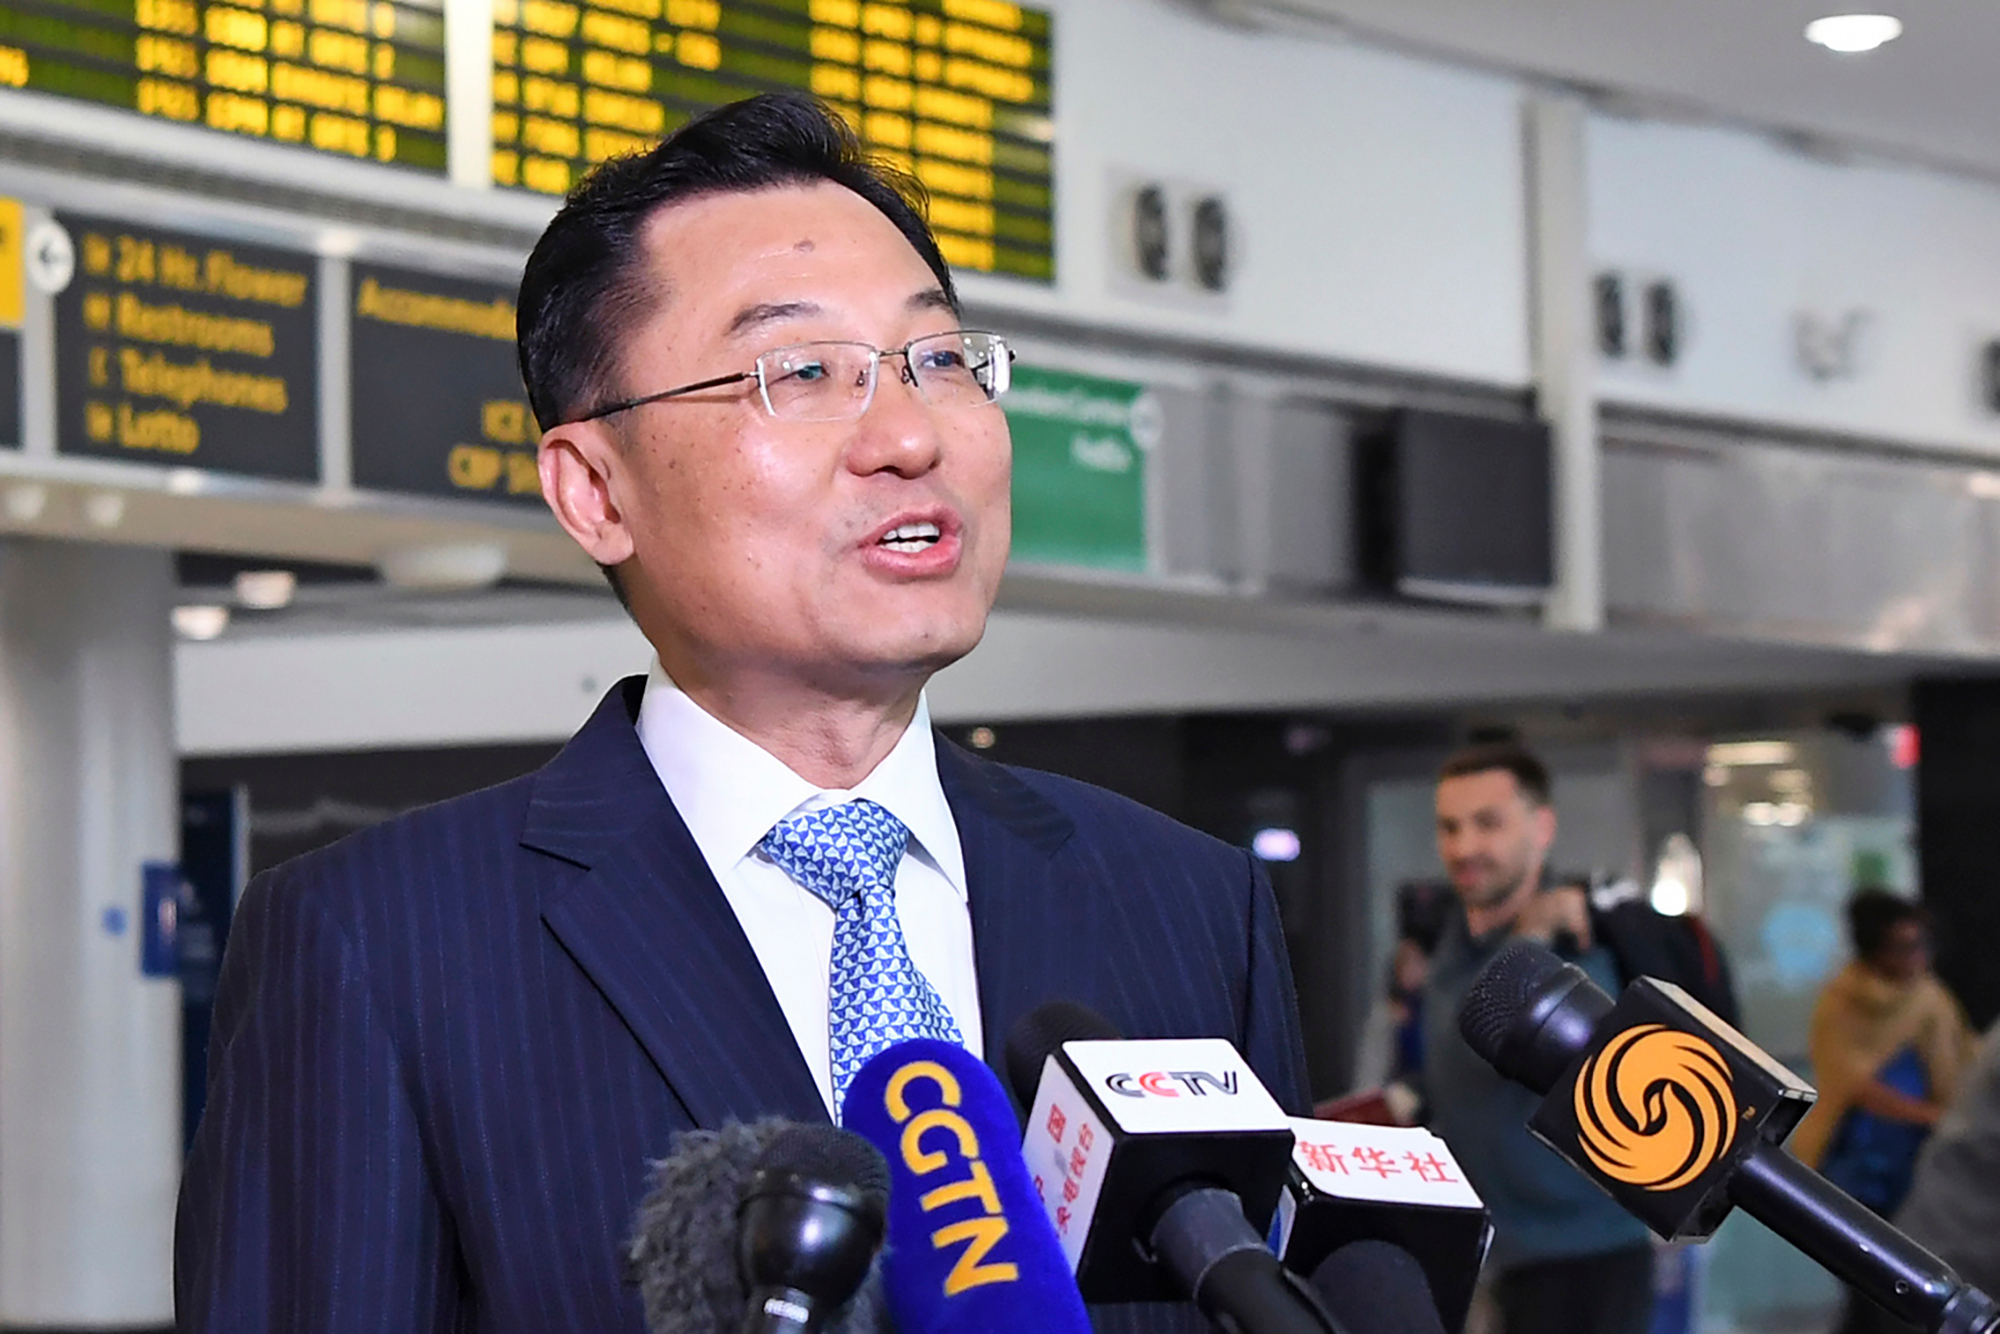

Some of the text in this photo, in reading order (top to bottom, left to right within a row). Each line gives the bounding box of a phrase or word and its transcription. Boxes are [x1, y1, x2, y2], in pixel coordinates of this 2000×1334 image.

[117, 235, 155, 283] 24
[116, 293, 274, 357] Restrooms
[119, 347, 288, 414] Telephones
[117, 403, 199, 454] Lotto
[1104, 1070, 1238, 1097] CCTV
[884, 1060, 1019, 1297] CGTN
[1297, 1141, 1459, 1183] 新华社
